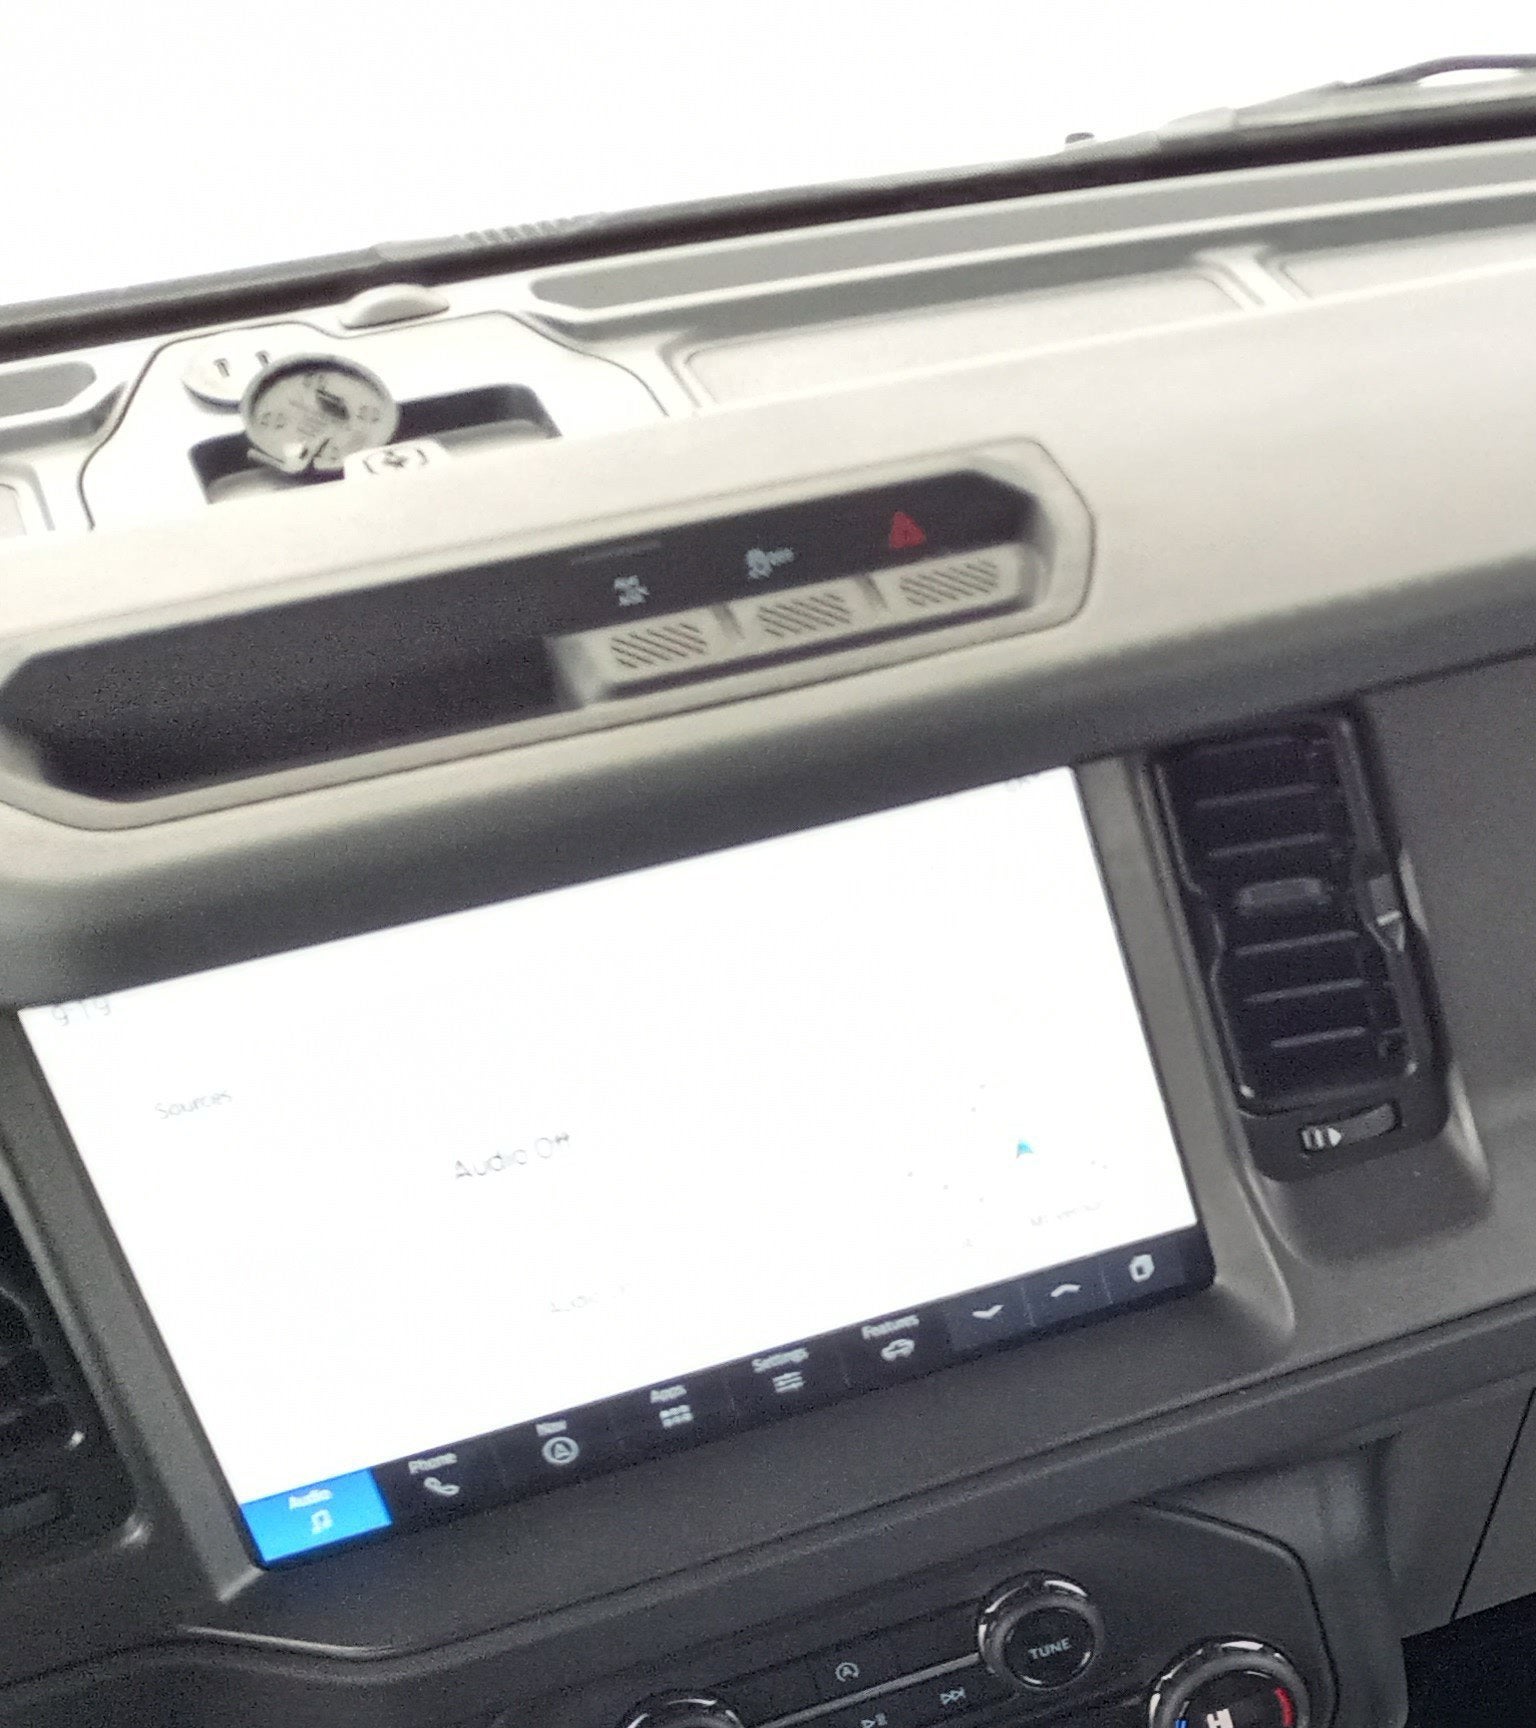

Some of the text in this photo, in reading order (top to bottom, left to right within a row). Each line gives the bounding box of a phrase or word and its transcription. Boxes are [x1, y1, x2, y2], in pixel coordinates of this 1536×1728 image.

[408, 1453, 457, 1474] Phone
[288, 1488, 333, 1510] Audio
[1028, 1638, 1071, 1660] TUNE
